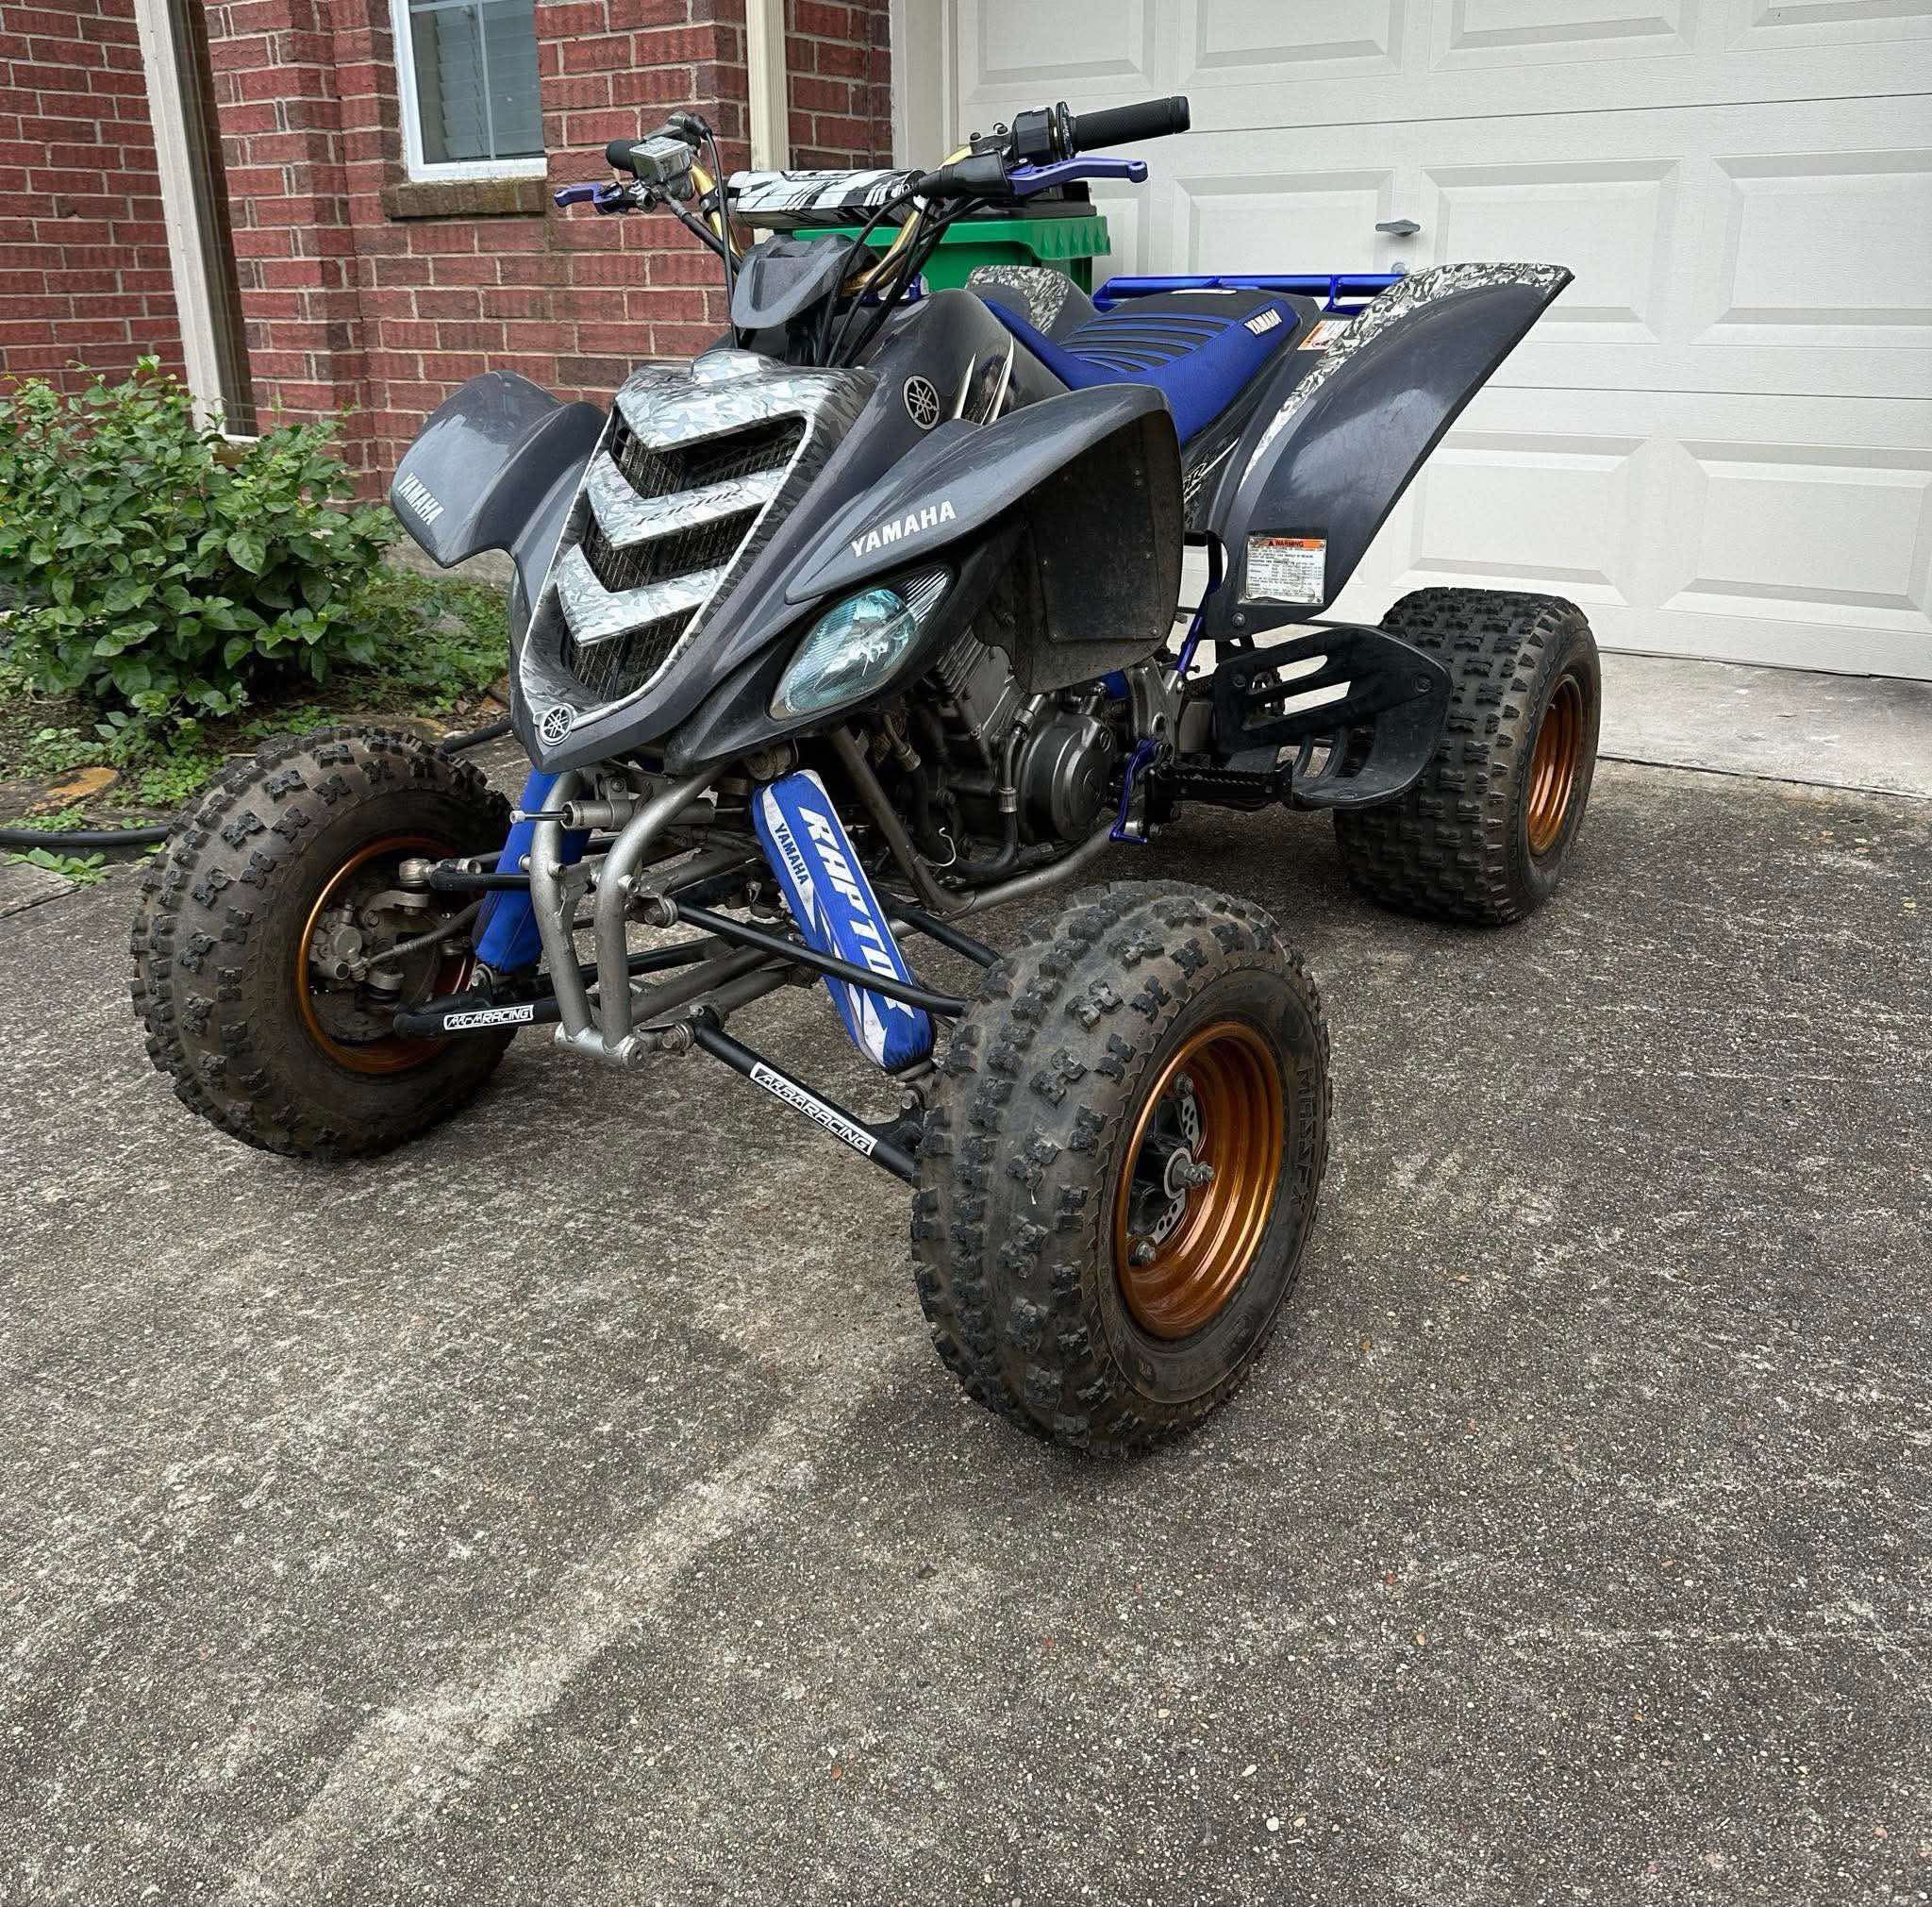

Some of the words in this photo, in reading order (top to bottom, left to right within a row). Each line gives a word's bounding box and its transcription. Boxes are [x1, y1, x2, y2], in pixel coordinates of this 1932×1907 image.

[397, 472, 444, 526] YAMAHA
[851, 500, 957, 558] YAMAHA
[774, 824, 808, 885] YAMAHA
